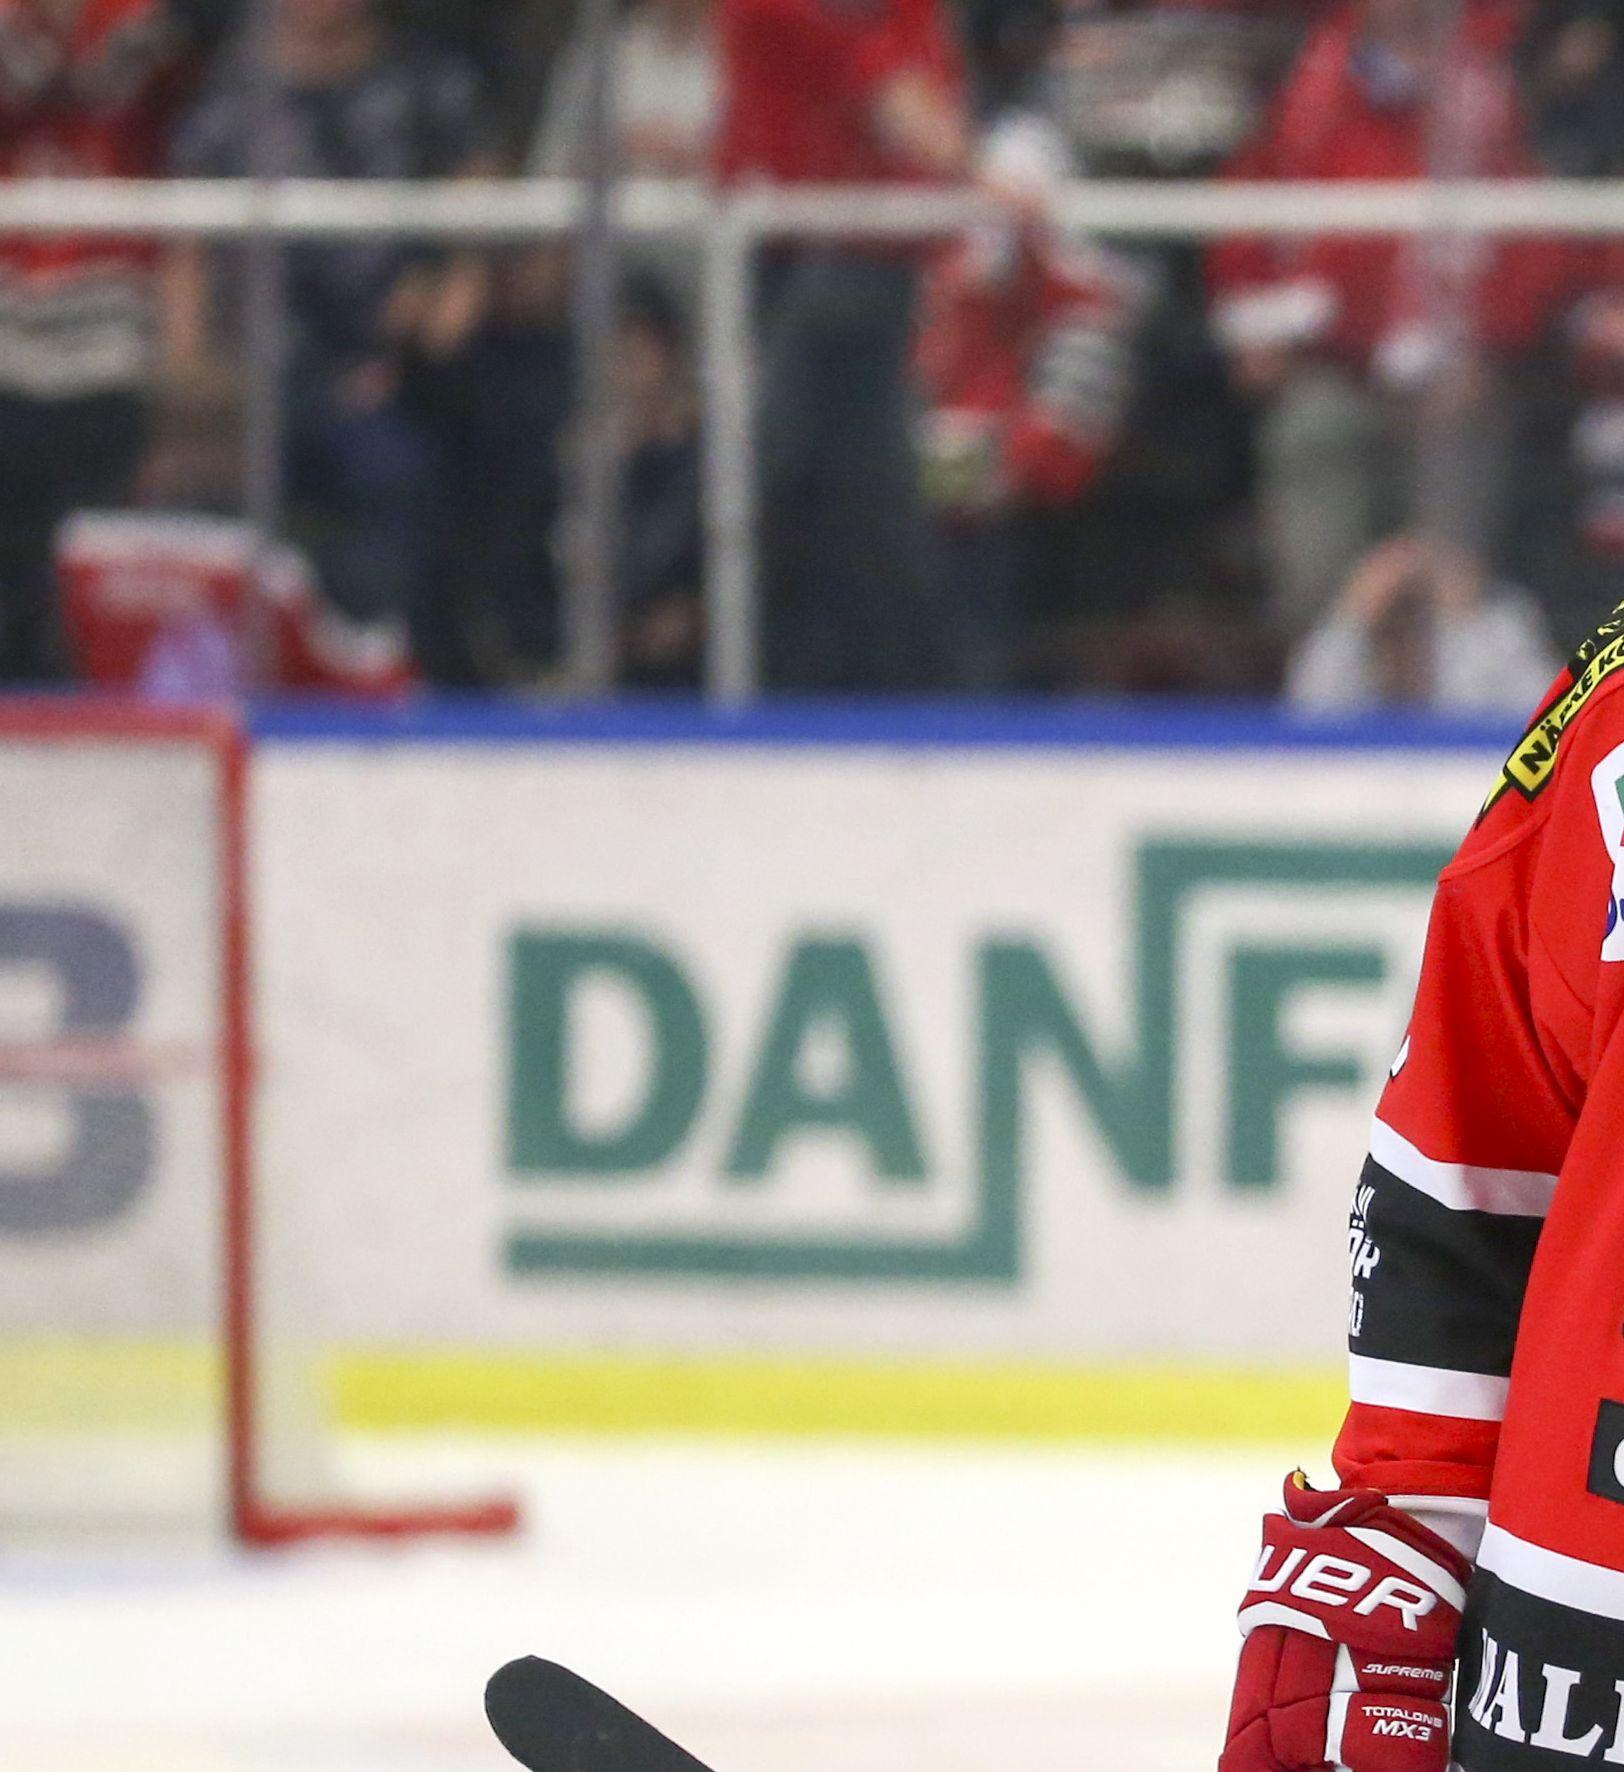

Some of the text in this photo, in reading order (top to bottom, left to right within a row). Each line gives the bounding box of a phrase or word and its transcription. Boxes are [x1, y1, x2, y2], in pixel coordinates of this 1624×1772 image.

[505, 840, 1445, 1280] DANF
[1248, 1544, 1438, 1632] UER
[1361, 1663, 1445, 1681] SUPREME
[1372, 1718, 1432, 1742] MX3
